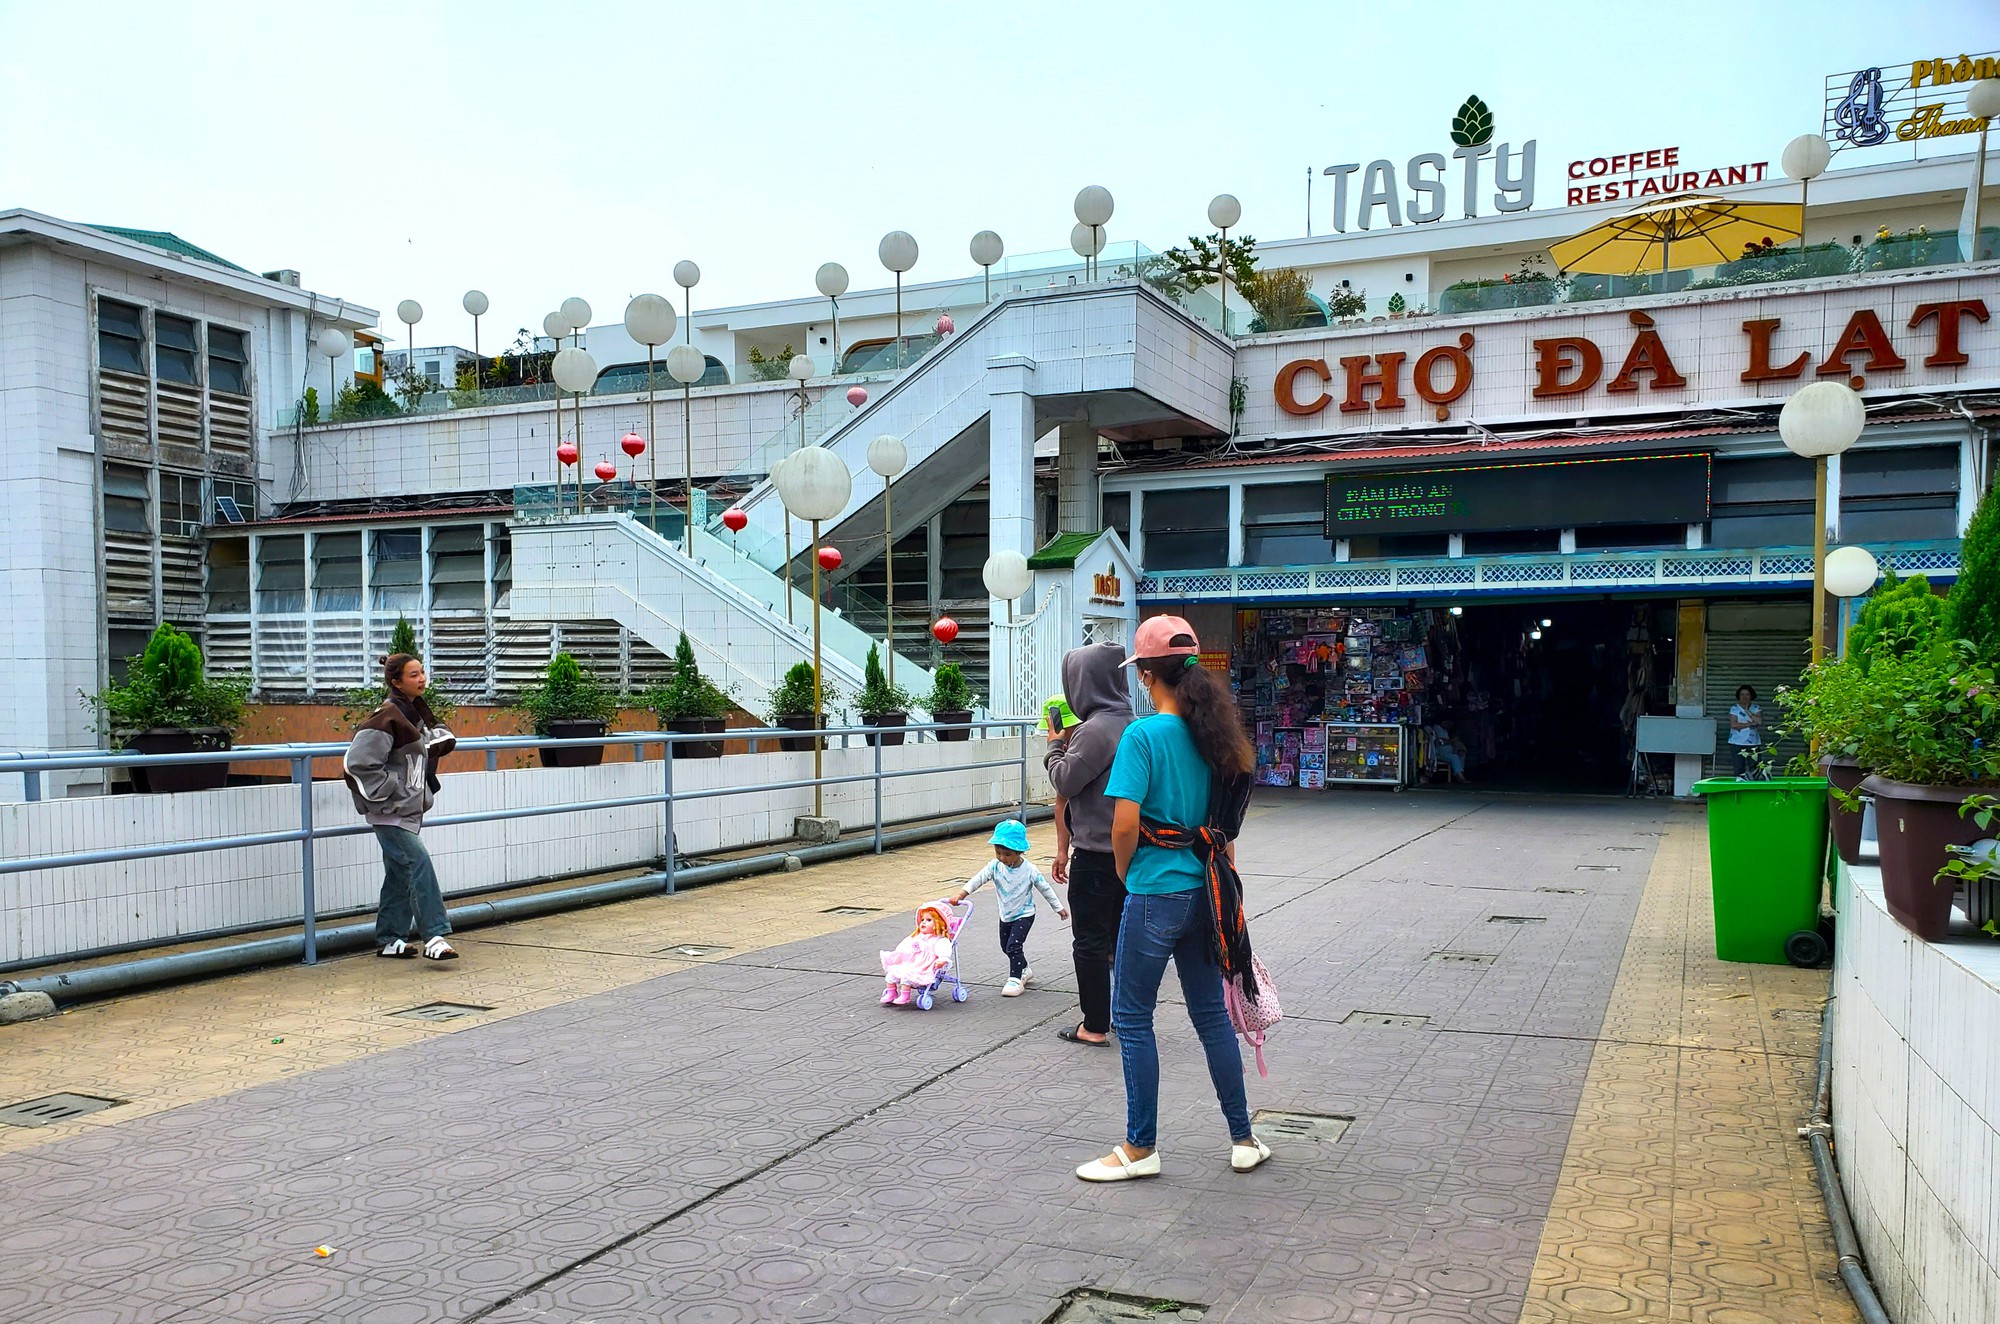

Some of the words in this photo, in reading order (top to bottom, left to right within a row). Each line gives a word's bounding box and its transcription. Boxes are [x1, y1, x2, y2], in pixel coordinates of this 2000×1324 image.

[1567, 161, 1769, 207] RESTAURANT
[1568, 146, 1680, 180] COFFEE
[1273, 332, 1475, 421] CHỢ
[1533, 310, 1687, 398] ĐÀ
[1740, 299, 1991, 391] LẠT
